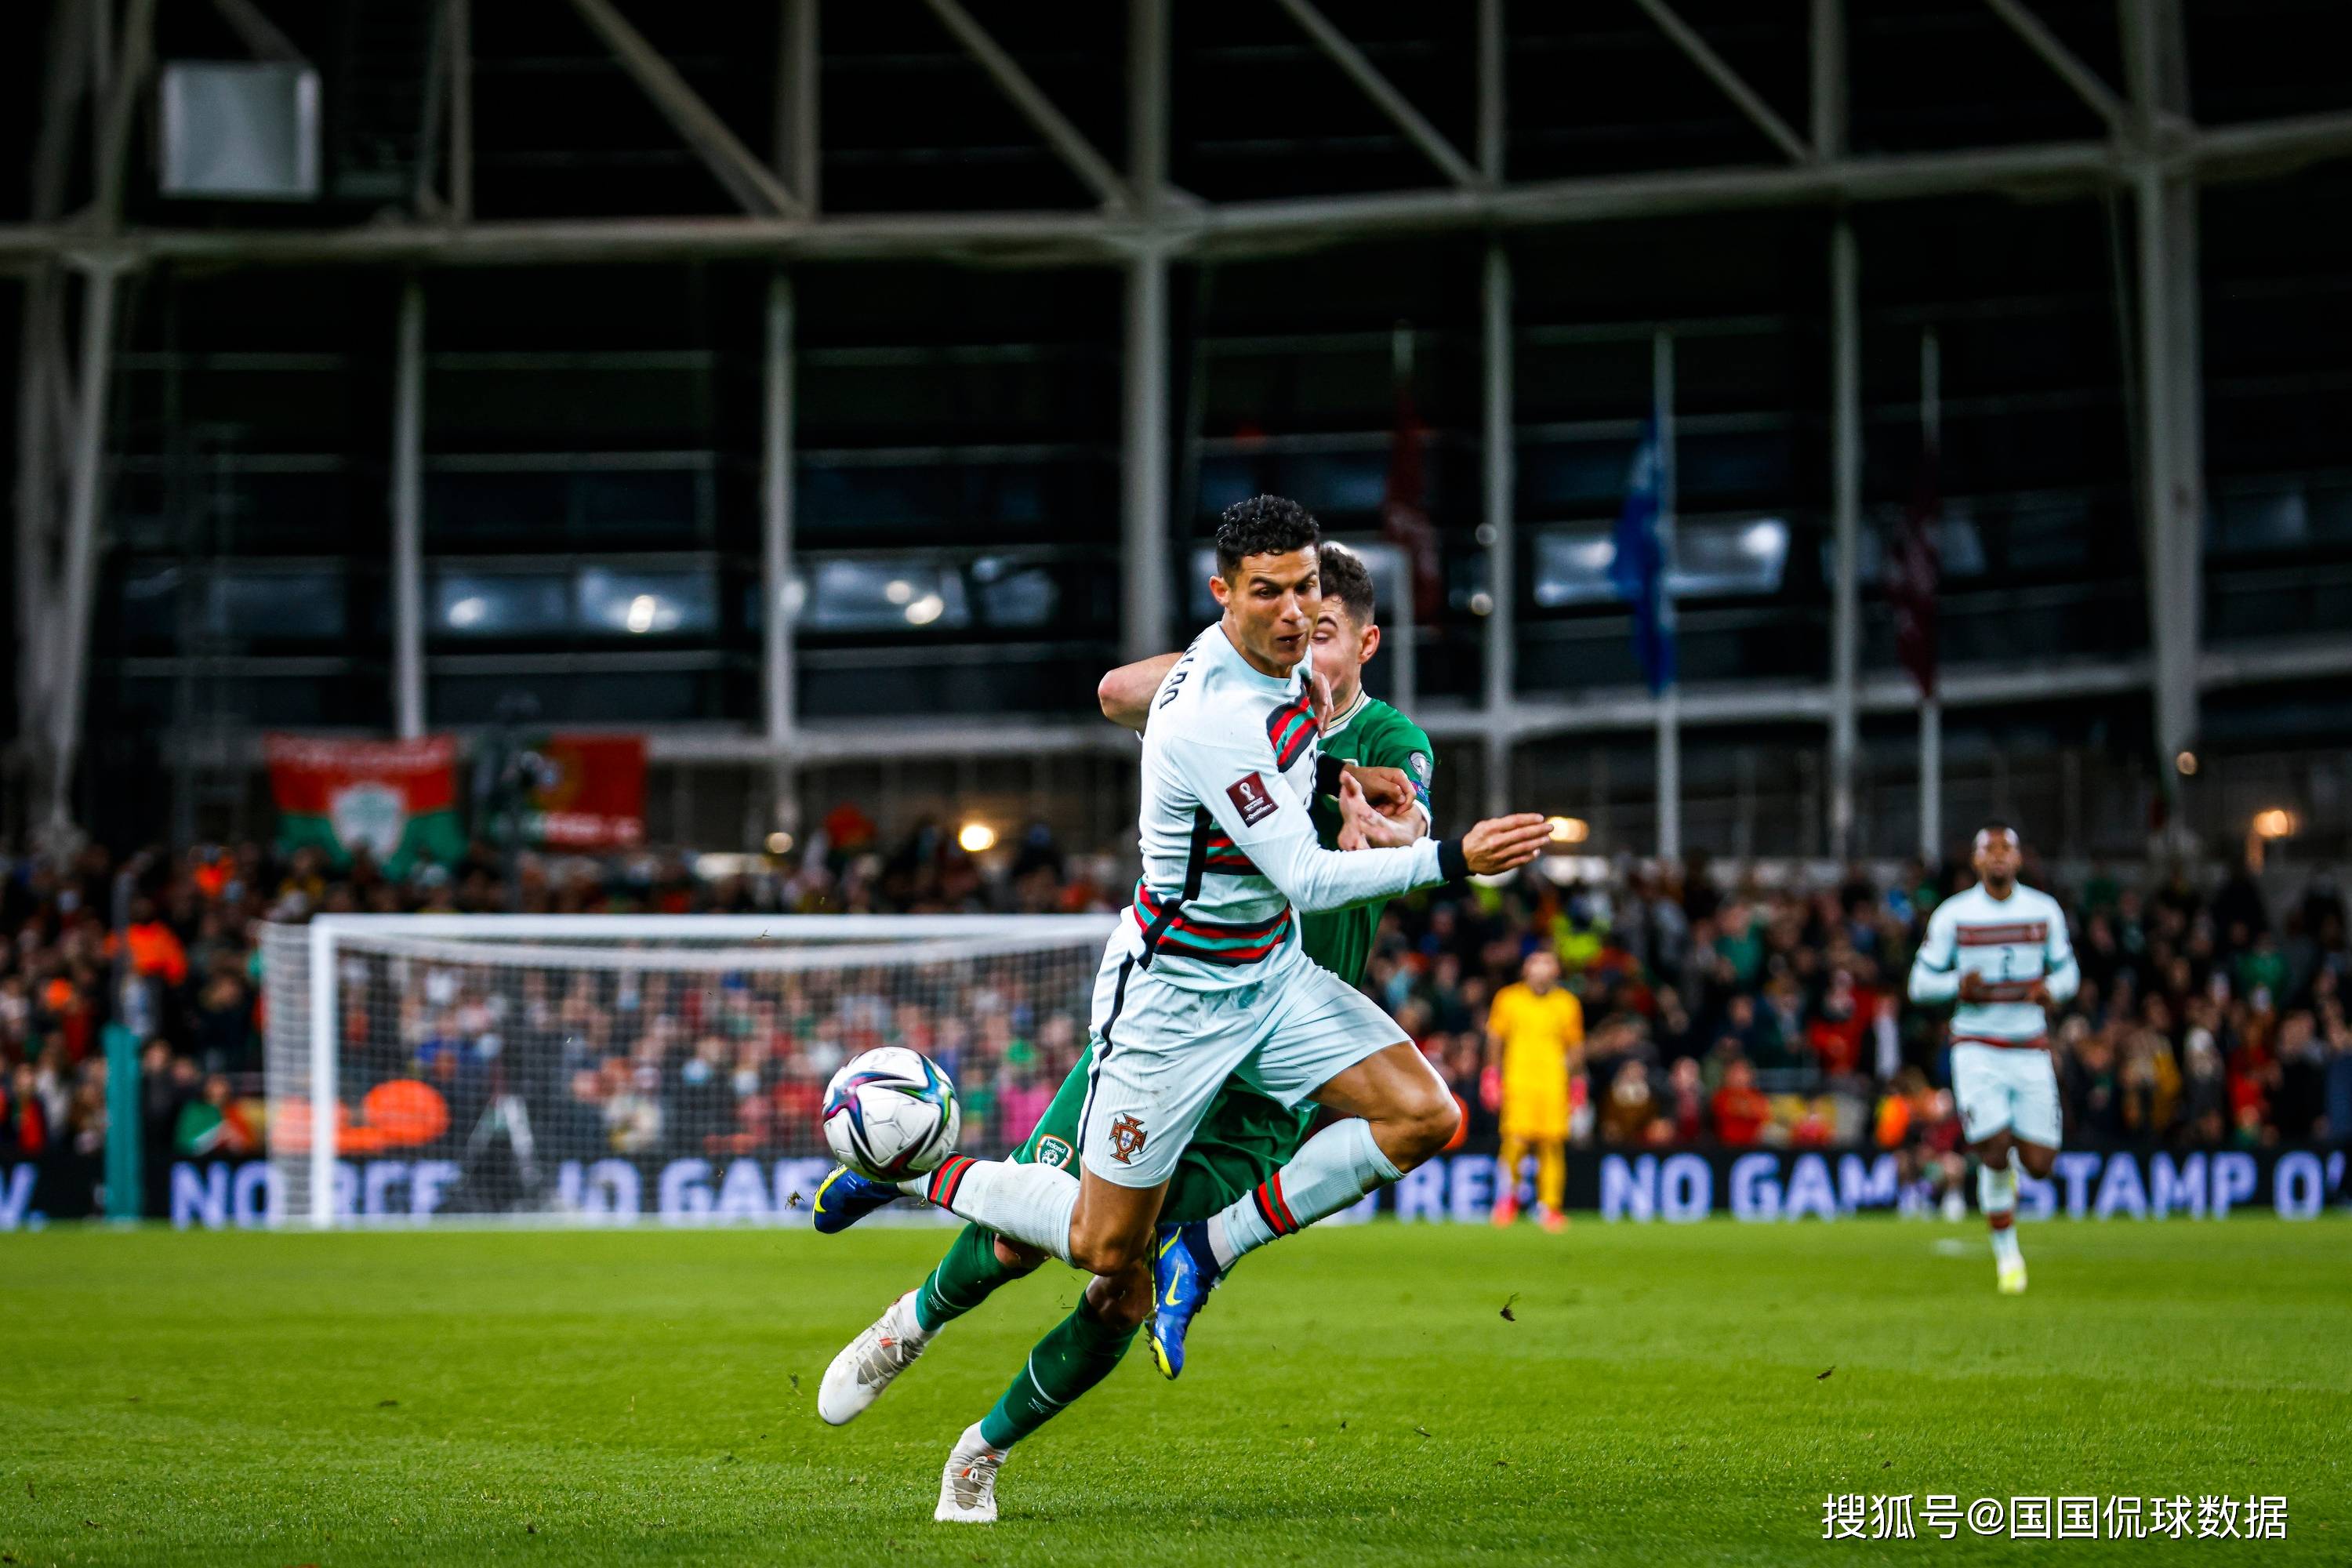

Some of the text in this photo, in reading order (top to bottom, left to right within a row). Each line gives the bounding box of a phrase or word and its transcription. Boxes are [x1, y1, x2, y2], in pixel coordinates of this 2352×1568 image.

[1046, 1138, 1067, 1154] Ireland
[170, 1160, 287, 1231] NO
[1600, 1152, 1935, 1225] NO GAM
